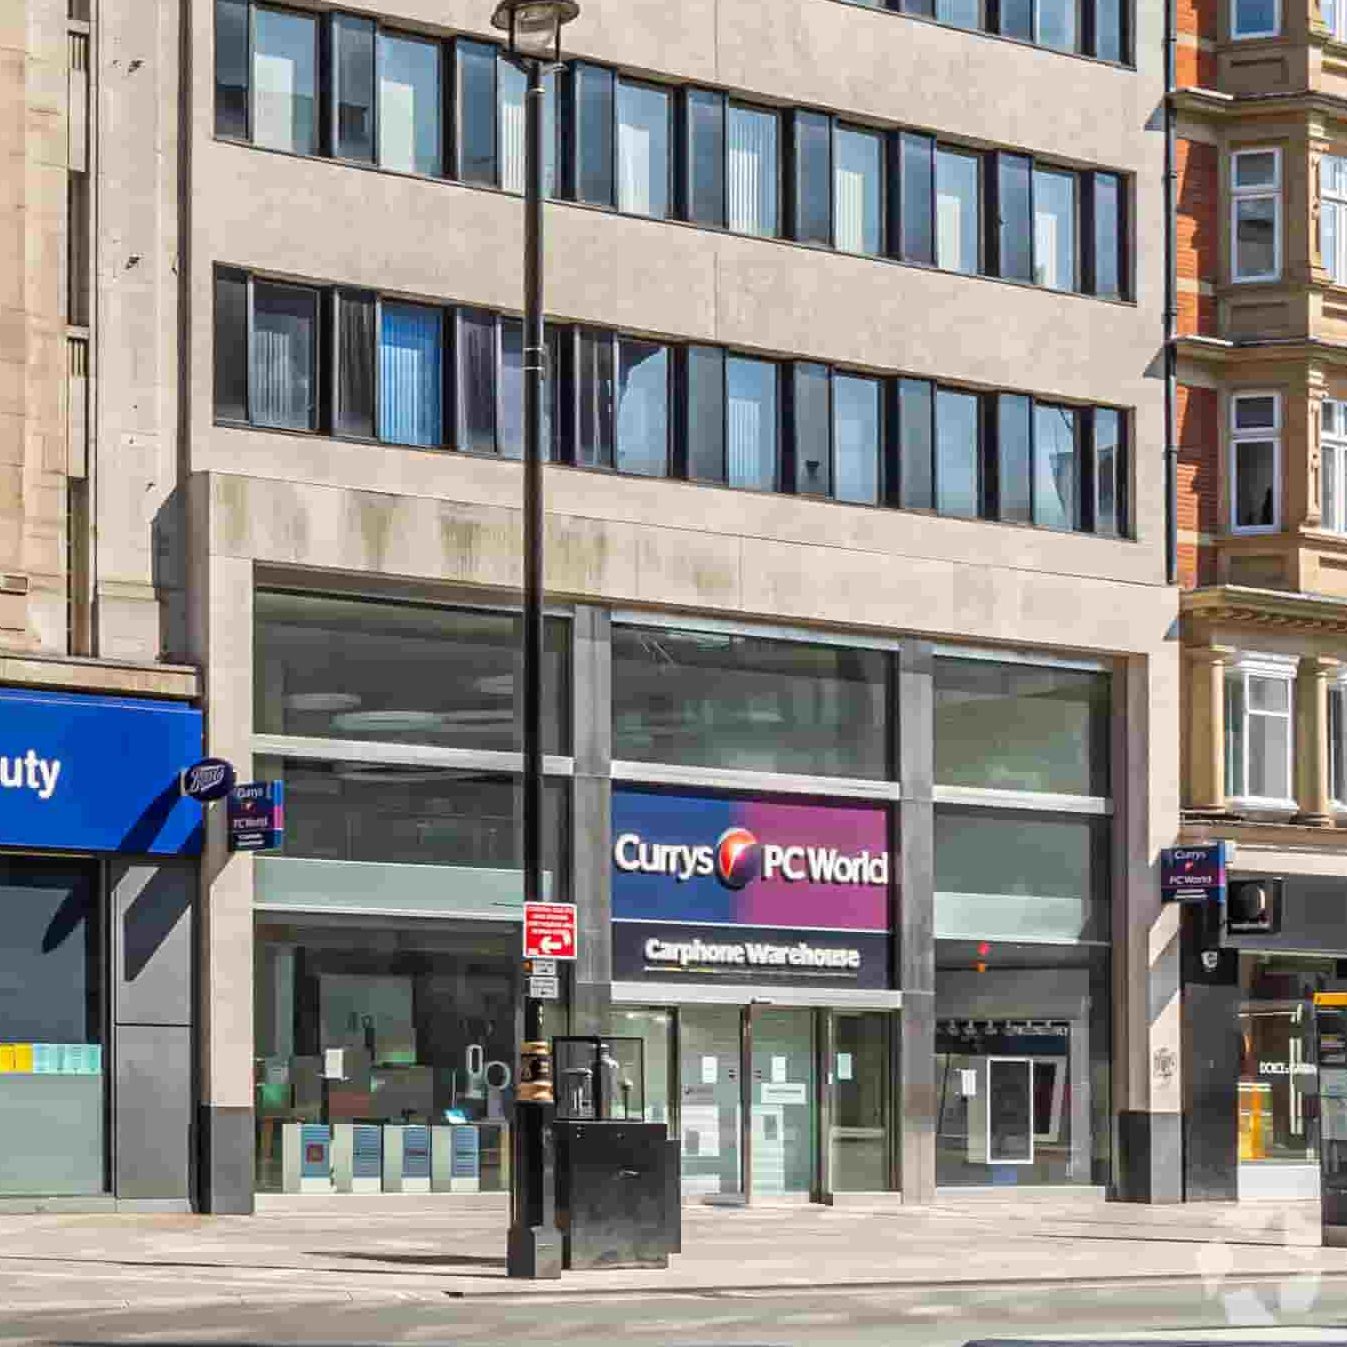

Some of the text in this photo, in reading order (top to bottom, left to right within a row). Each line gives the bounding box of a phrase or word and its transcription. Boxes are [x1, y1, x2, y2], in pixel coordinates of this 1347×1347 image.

[613, 832, 889, 885] Currys PC World
[643, 938, 863, 969] Carphone Warehouse
